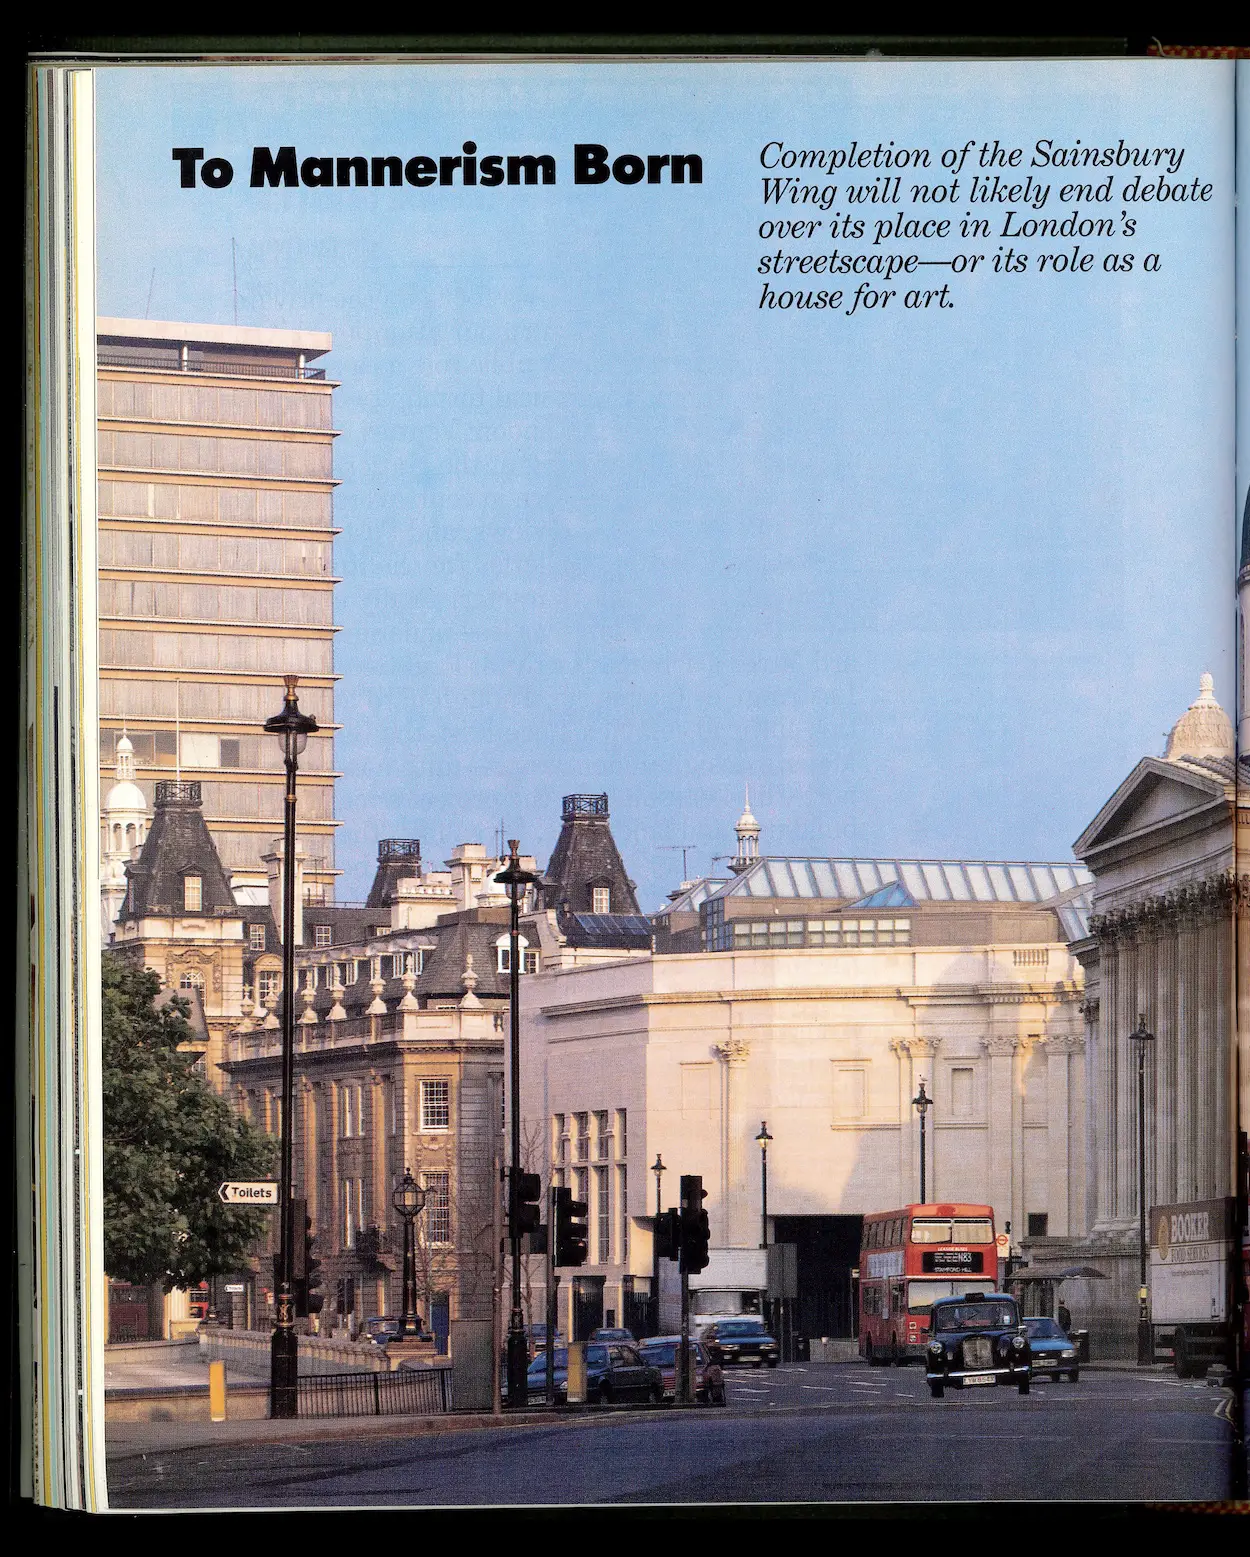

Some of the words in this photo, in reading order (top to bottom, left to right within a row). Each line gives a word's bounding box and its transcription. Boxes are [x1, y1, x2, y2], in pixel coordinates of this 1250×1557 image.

[231, 1187, 272, 1198] Toilets
[1171, 1212, 1209, 1243] BOOKER
[1171, 1247, 1186, 1262] FOOD
[1186, 1245, 1210, 1261] SERVICES
